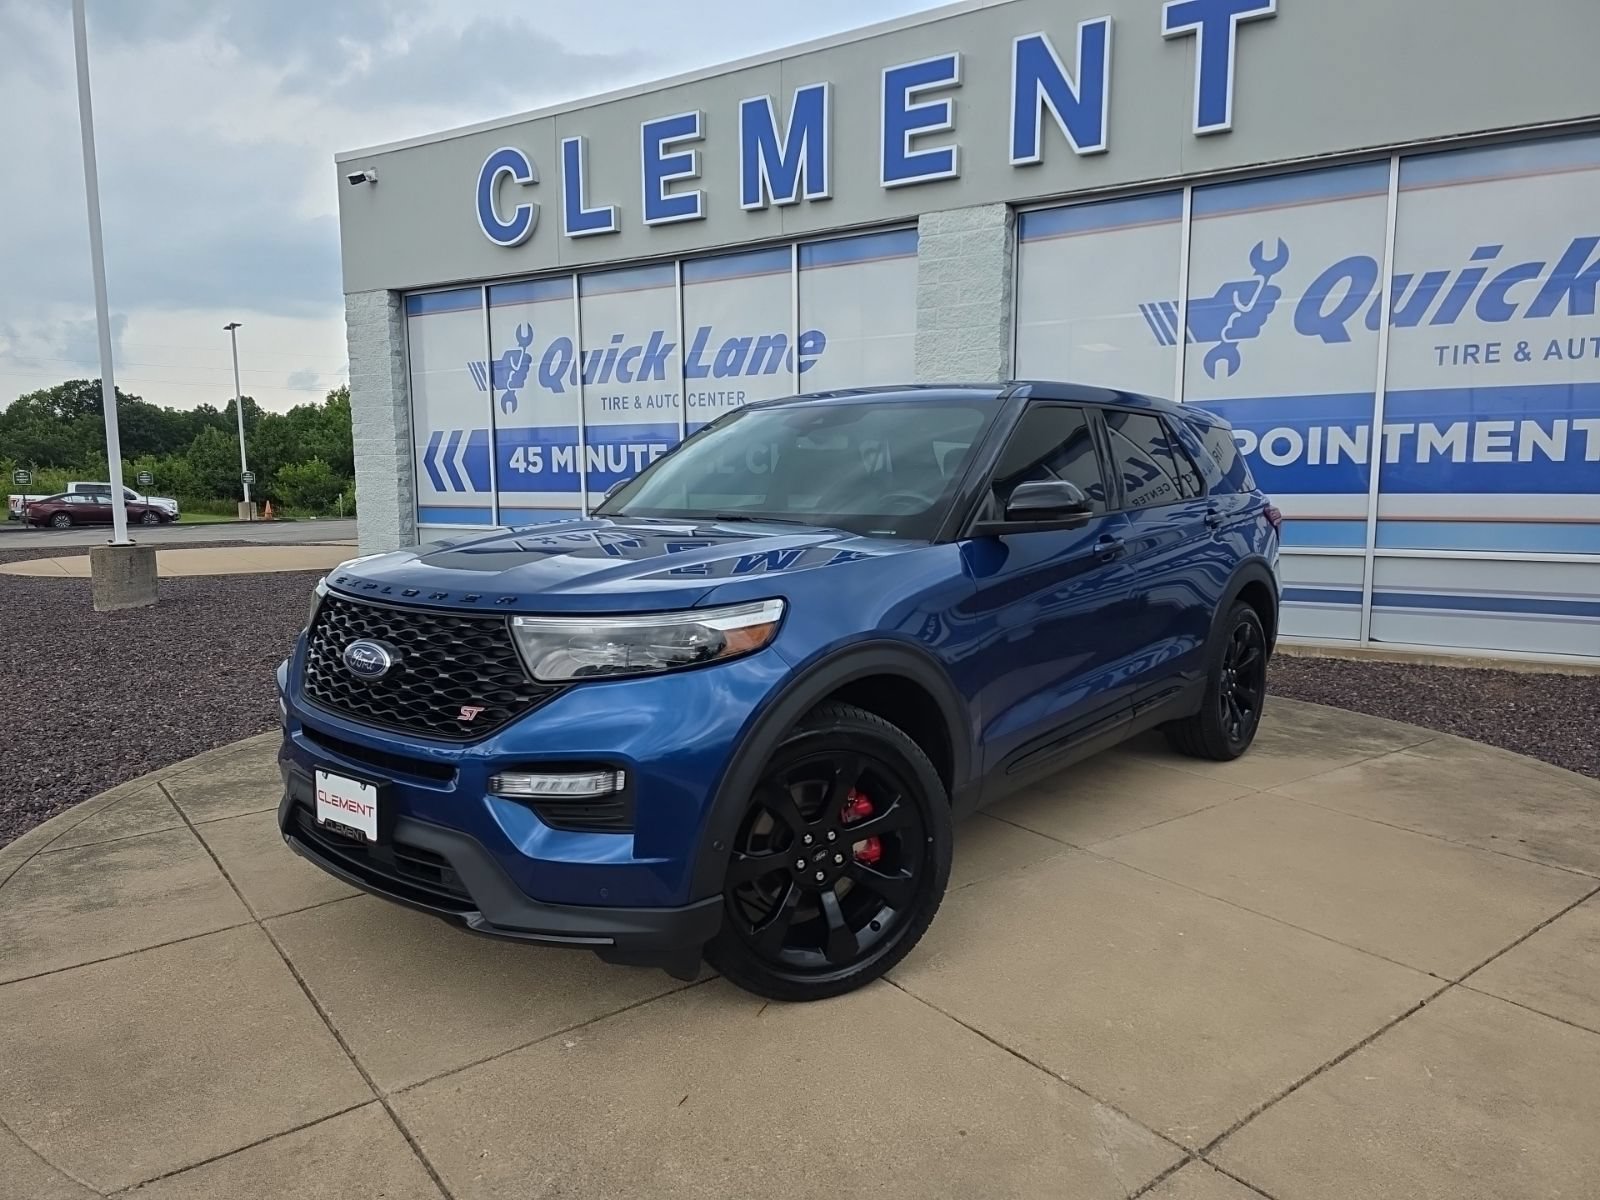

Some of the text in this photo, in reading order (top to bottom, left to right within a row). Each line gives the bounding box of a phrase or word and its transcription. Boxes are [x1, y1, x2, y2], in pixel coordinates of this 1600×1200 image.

[475, 0, 1277, 248] CLEMENT
[1294, 236, 1600, 343] Quick
[538, 326, 826, 394] Quick Lane
[1434, 342, 1501, 367] TIRE
[1513, 341, 1532, 362] &
[601, 396, 629, 410] TIRE
[634, 396, 642, 409] &
[688, 391, 746, 407] CENTER
[509, 446, 544, 474] 45
[335, 577, 518, 605] EXPLORER
[350, 648, 378, 671] Ford
[457, 705, 485, 721] ST
[317, 789, 375, 819] CLEMENT
[325, 820, 365, 842] CLEMENT
